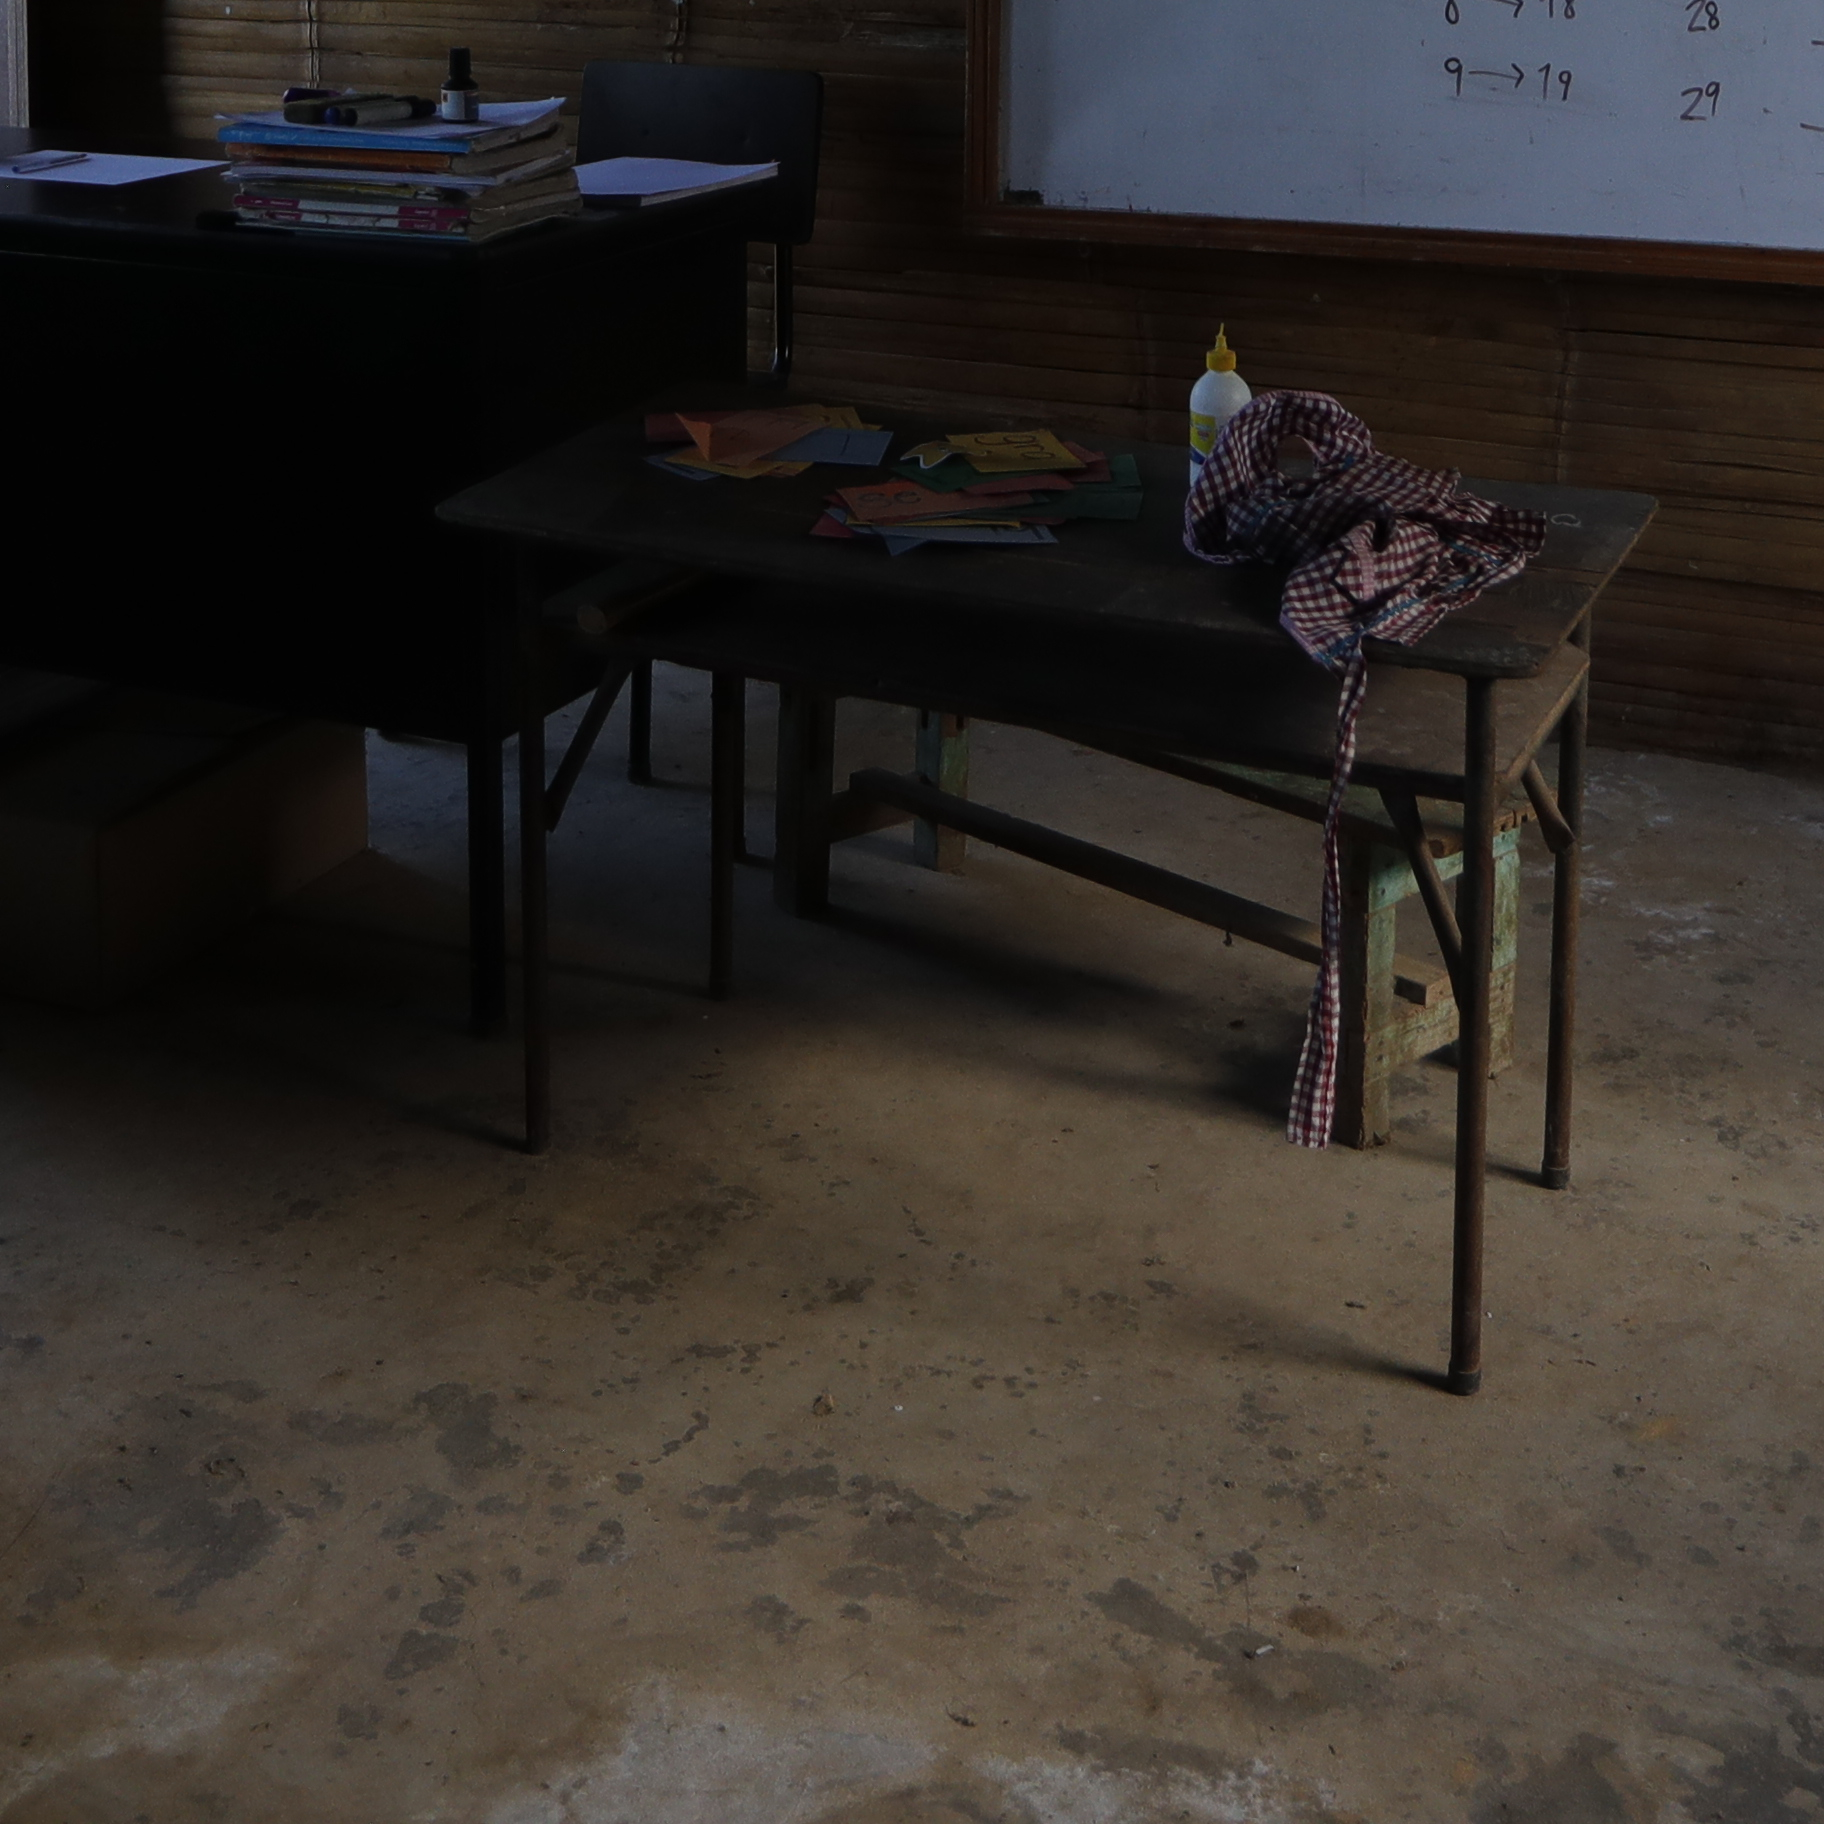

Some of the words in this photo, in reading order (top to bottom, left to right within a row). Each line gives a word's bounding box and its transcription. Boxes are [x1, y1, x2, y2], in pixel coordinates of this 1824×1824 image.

[1444, 57, 1464, 96] 9
[1538, 63, 1571, 101] 19
[1681, 81, 1721, 121] 29
